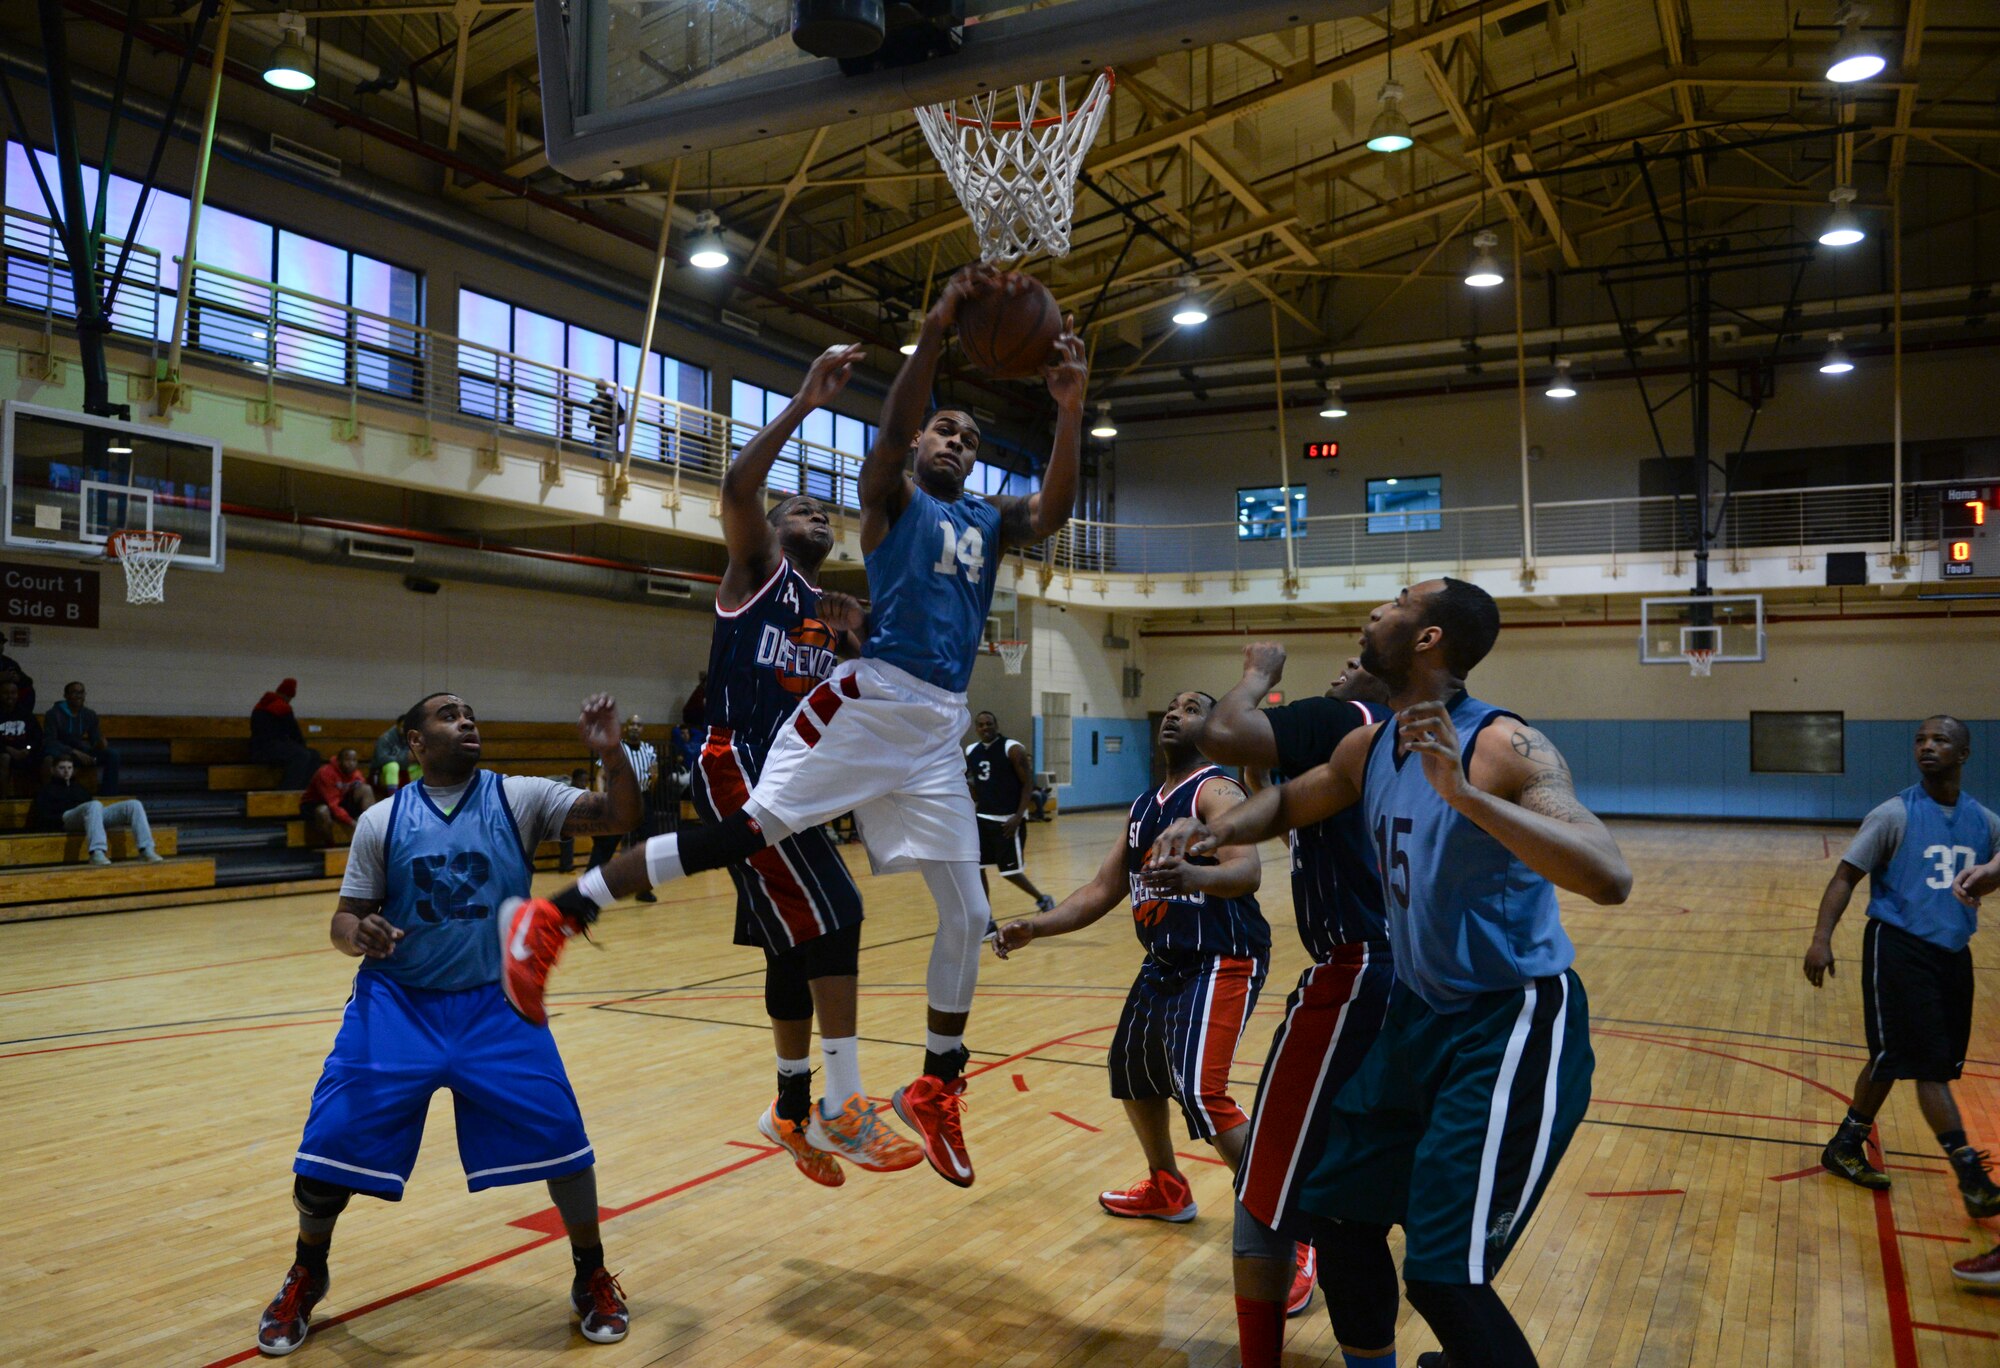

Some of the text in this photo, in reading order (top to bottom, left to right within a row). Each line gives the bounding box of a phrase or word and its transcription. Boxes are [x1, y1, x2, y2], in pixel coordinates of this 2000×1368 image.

[1948, 489, 1977, 500] Home
[1965, 501, 1983, 524] 7
[933, 520, 984, 584] 14
[1953, 542, 1969, 560] 0
[5, 571, 83, 593] Court 1
[8, 599, 80, 620] Side B
[978, 761, 991, 781] 3
[1374, 814, 1413, 910] 15
[412, 851, 489, 923] 52
